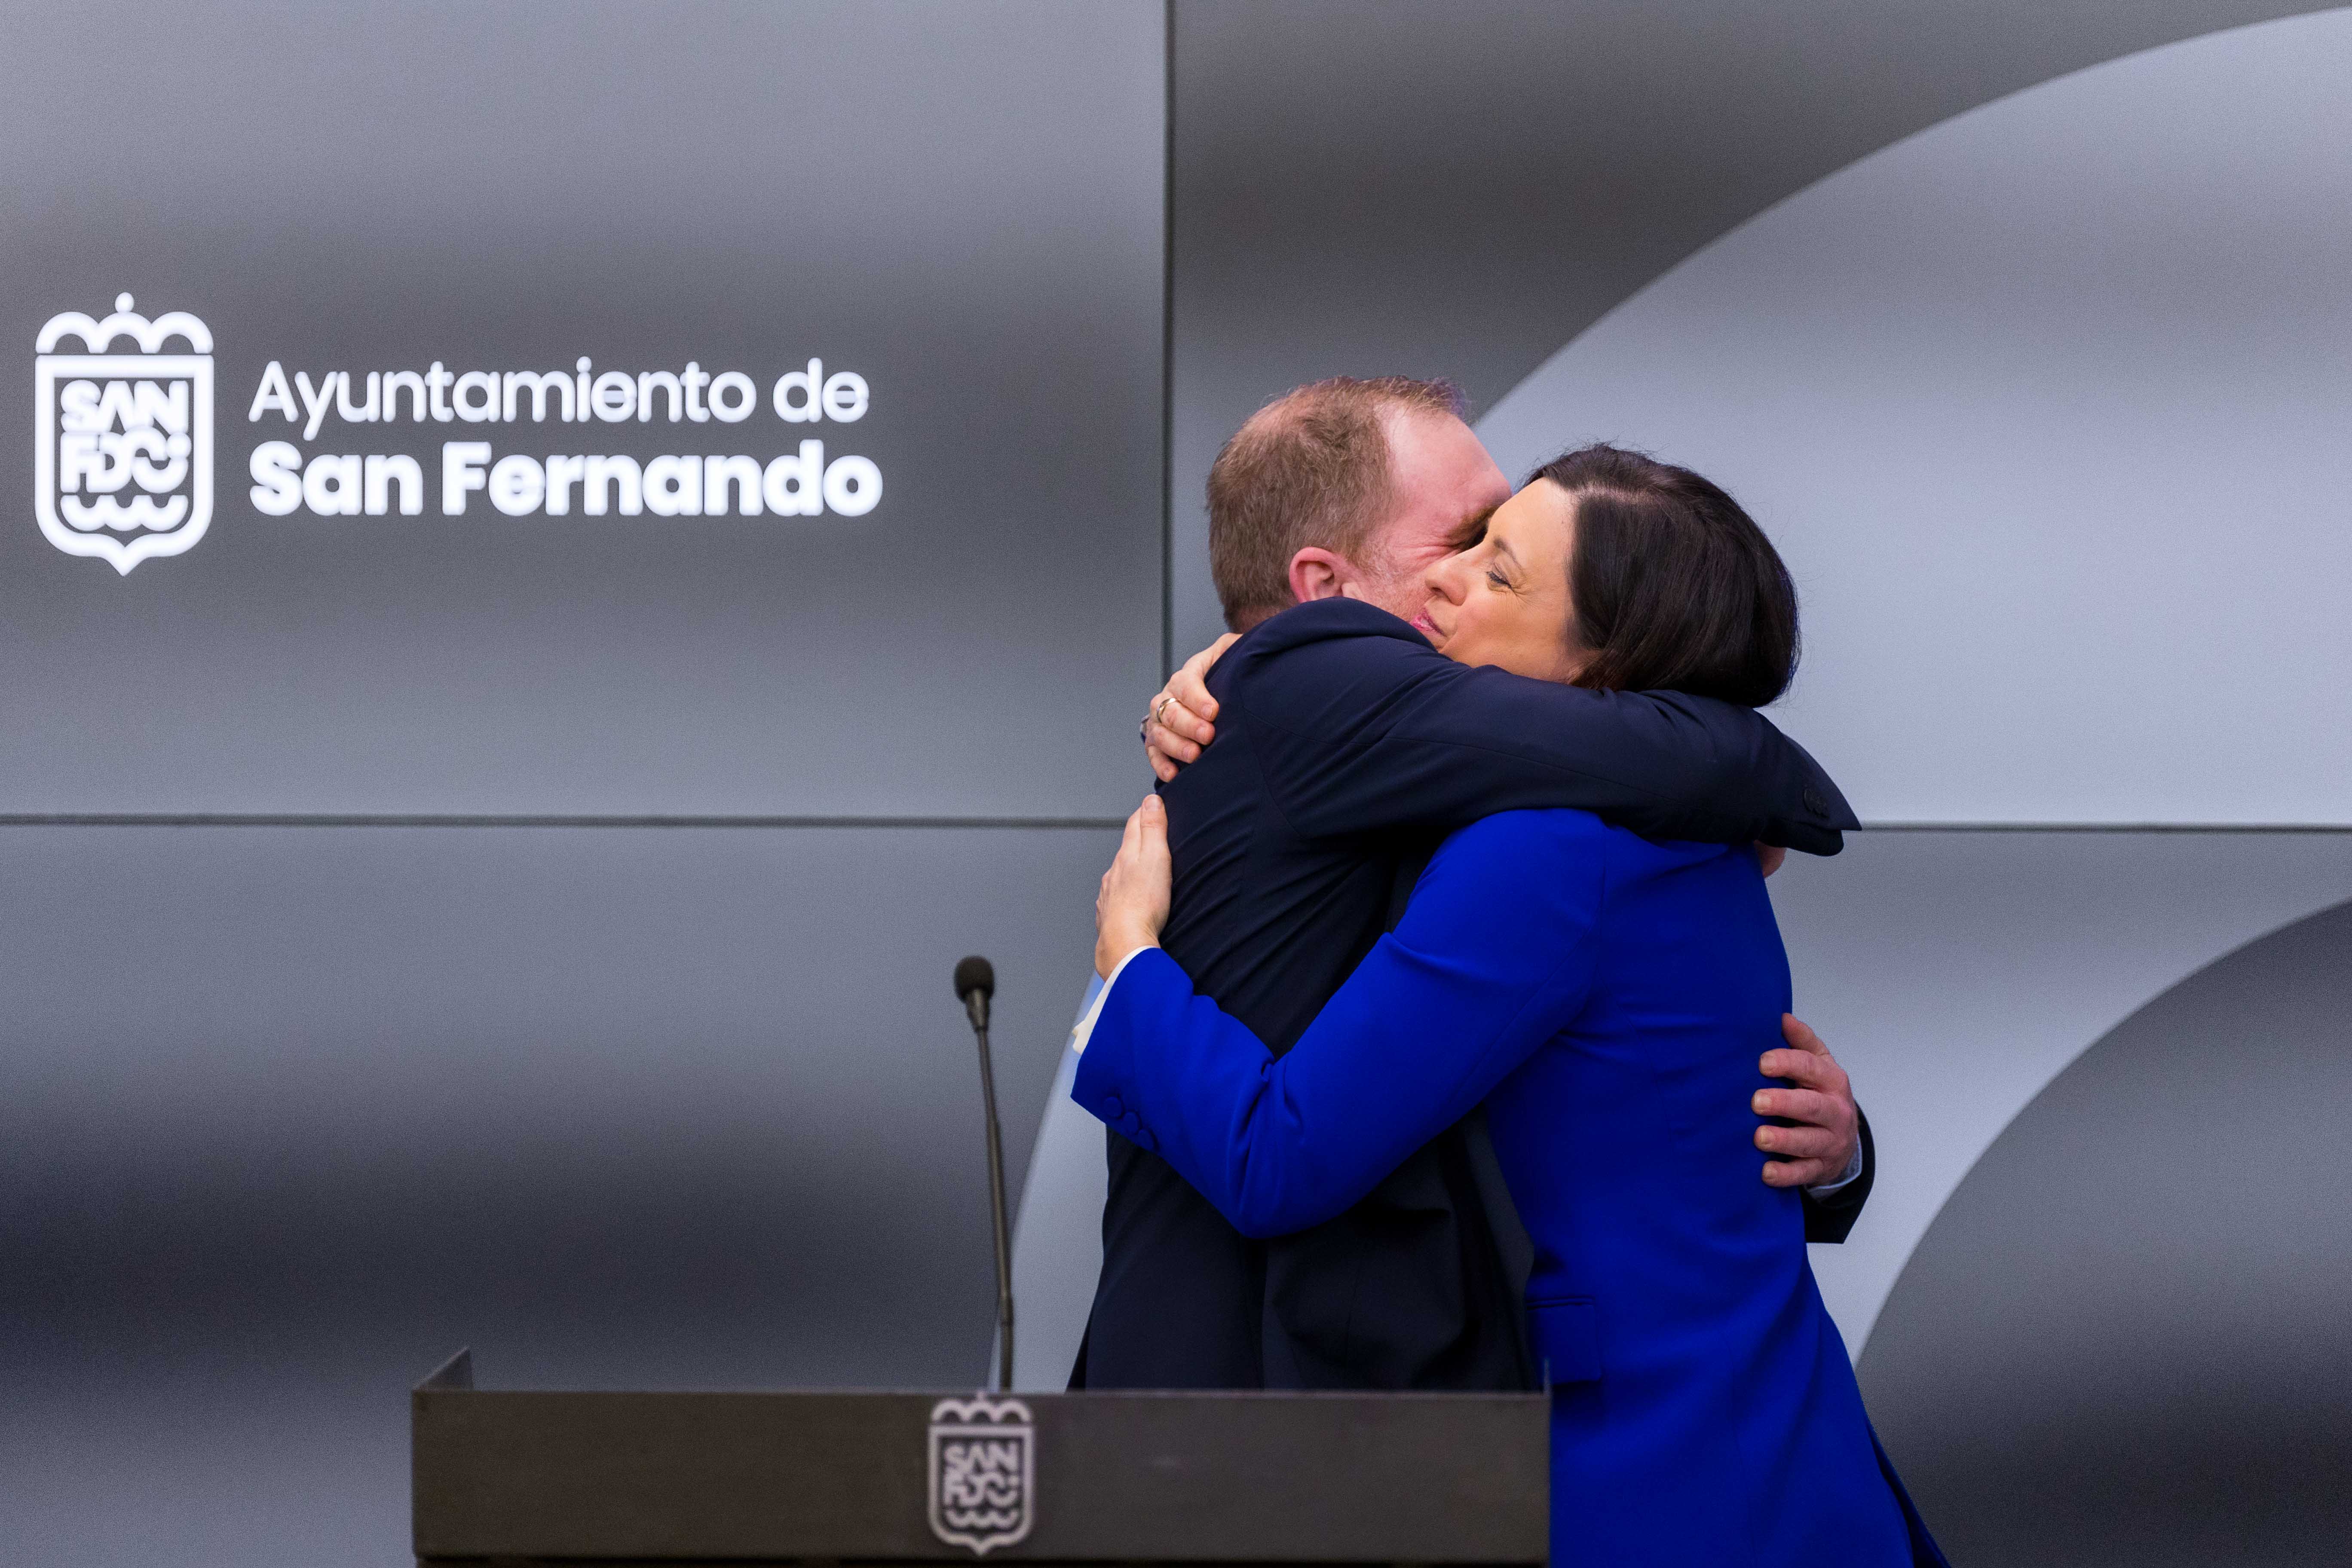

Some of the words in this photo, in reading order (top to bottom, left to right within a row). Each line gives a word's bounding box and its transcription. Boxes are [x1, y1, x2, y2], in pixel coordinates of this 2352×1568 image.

[60, 380, 189, 432] SAN
[248, 356, 756, 441] Ayuntamiento
[773, 358, 869, 422] de
[249, 441, 423, 516] San
[442, 439, 883, 516] Fernando
